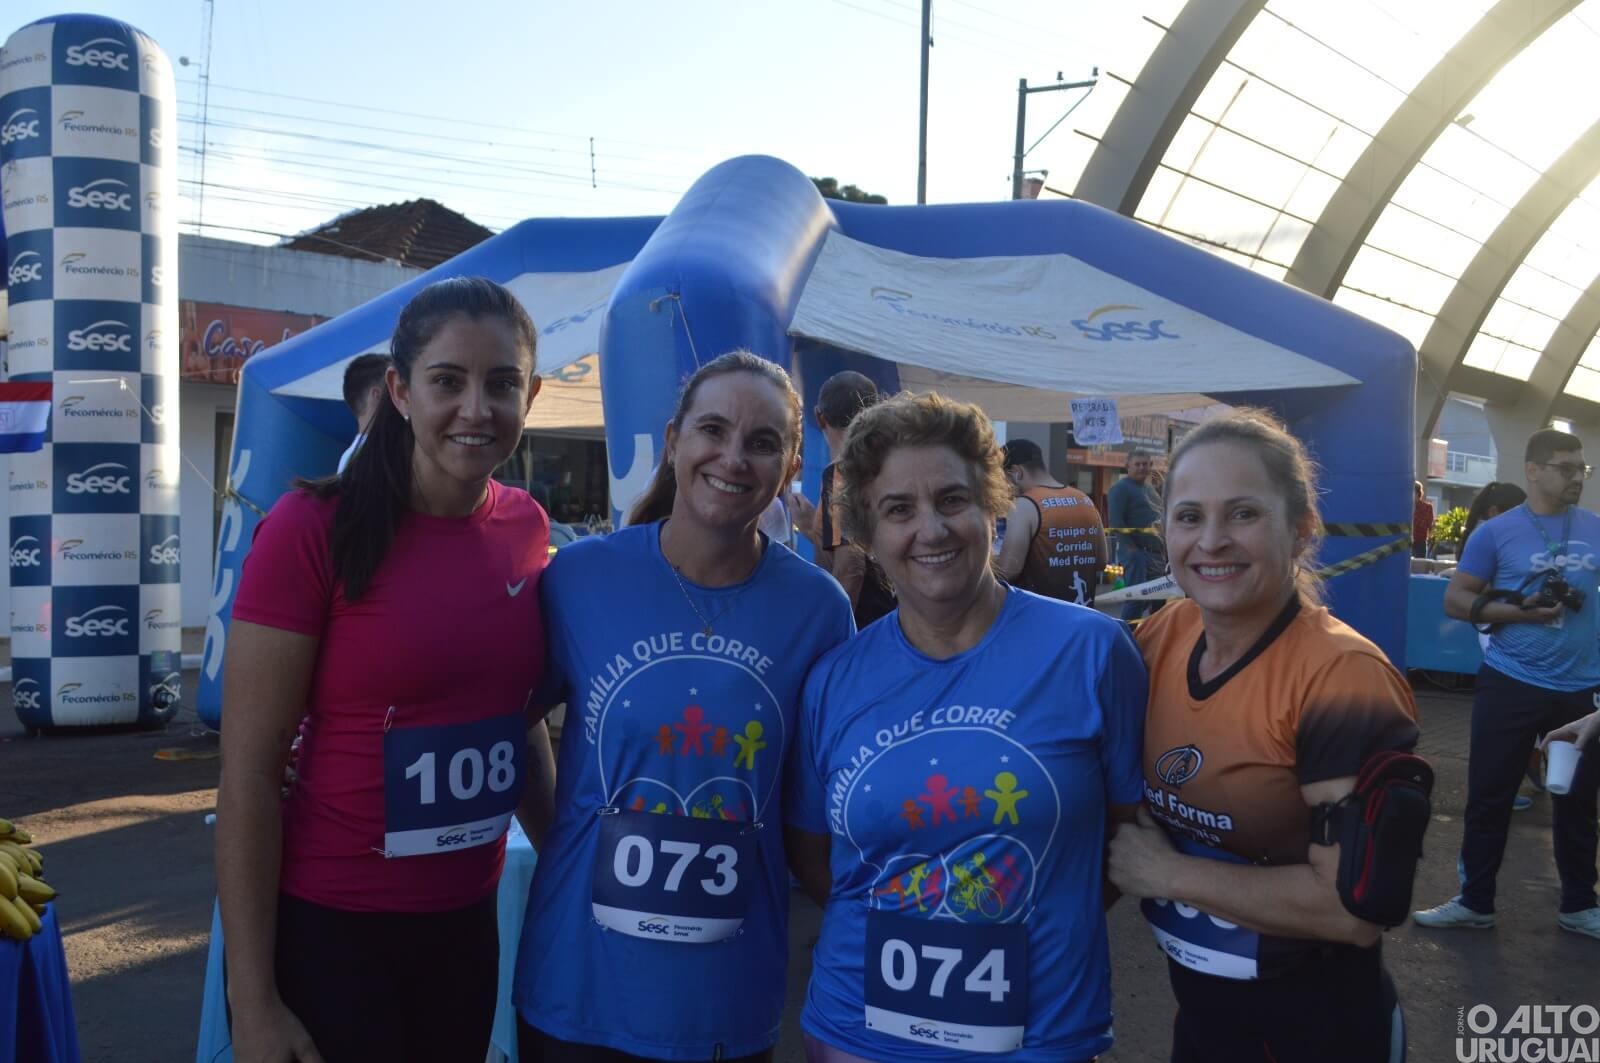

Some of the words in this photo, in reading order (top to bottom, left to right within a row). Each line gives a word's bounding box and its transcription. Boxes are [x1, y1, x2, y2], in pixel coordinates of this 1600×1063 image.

[64, 122, 122, 135] Fecomércio
[125, 128, 137, 137] RS
[65, 265, 124, 277] Fecomércio
[126, 268, 139, 278] RS
[37, 336, 48, 346] RS
[64, 407, 123, 418] Fecomércio
[125, 409, 138, 418] RS
[36, 480, 48, 489] RS
[1042, 496, 1078, 508] SEBERI
[1048, 527, 1086, 539] Equipe
[1056, 541, 1093, 552] Corrida
[63, 551, 122, 560] Fecomércio
[124, 551, 137, 560] RS
[1049, 556, 1071, 568] Med
[1530, 552, 1597, 573] Ssc
[35, 623, 48, 633] RS
[585, 653, 633, 745] FAMÍLIA
[632, 631, 684, 662] QUE
[691, 632, 774, 675] CORRE
[62, 694, 121, 705] Fecomércio
[123, 692, 137, 702] RS
[405, 740, 516, 805] 108
[830, 745, 875, 836] FAMÍLIA
[875, 710, 925, 747] QUE
[931, 705, 1017, 730] CORRE
[1168, 793, 1233, 830] Forma
[613, 834, 739, 896] 073
[880, 938, 1010, 1002] 074
